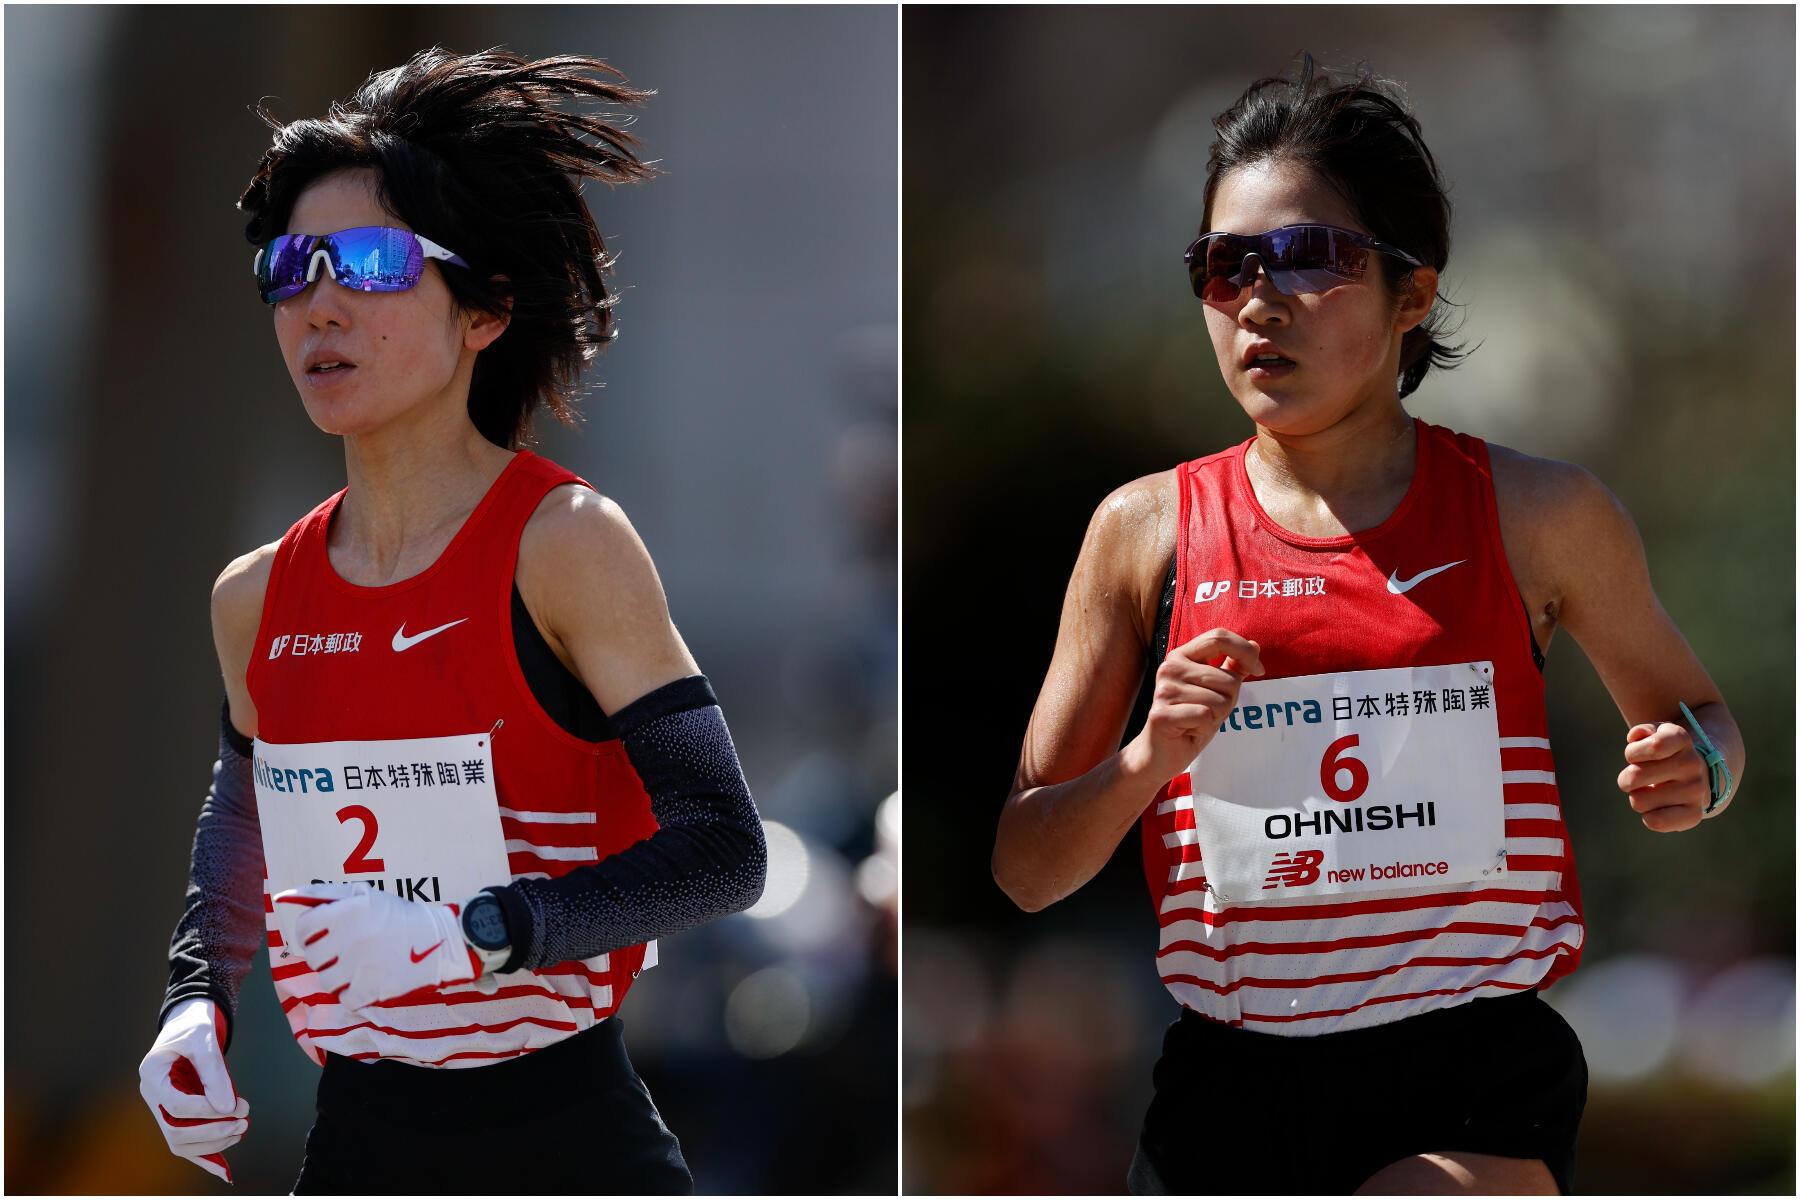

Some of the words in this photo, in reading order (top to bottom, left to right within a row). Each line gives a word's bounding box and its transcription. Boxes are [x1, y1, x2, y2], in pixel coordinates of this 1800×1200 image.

[1238, 575, 1327, 599] 日本郵政
[292, 631, 363, 656] 日本郵政
[1219, 699, 1322, 733] terra
[1332, 685, 1491, 721] 日本特殊陶業
[253, 753, 335, 793] Niterra
[343, 759, 486, 790] 日本特殊陶業
[1319, 733, 1369, 803] 6
[335, 804, 386, 875] 2
[1264, 801, 1437, 840] OHNISHI
[1261, 849, 1325, 890] NB
[1327, 867, 1366, 884] new
[1370, 861, 1449, 881] balance
